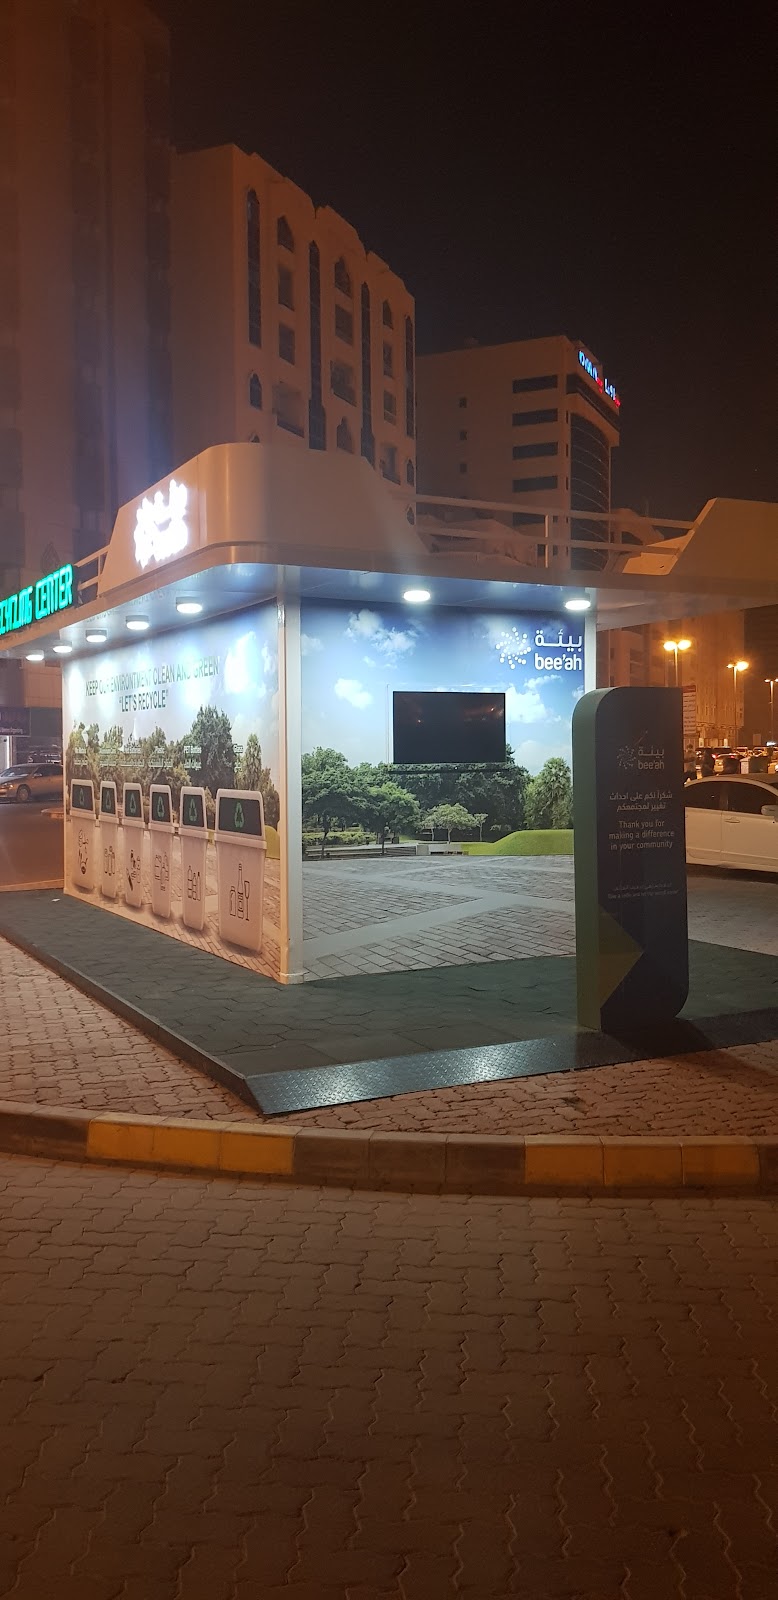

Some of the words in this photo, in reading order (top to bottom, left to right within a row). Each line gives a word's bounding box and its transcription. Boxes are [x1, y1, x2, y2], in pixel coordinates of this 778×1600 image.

[0, 586, 33, 635] CYCLING
[35, 563, 73, 620] CENTER
[534, 628, 582, 652] بيئة
[534, 653, 582, 670] bee'ah
[86, 679, 98, 696] KEEP
[152, 663, 175, 686] CLEAN
[194, 655, 219, 679] GREEN
[638, 760, 664, 770] bee'ah
[630, 792, 643, 802] على
[644, 791, 655, 801] لكم
[618, 820, 640, 829] Thank
[641, 821, 653, 829] you
[655, 819, 665, 827] for
[608, 831, 634, 840] making
[642, 830, 674, 838] difference
[610, 842, 617, 850] in
[620, 842, 634, 851] your
[636, 840, 673, 849] community
